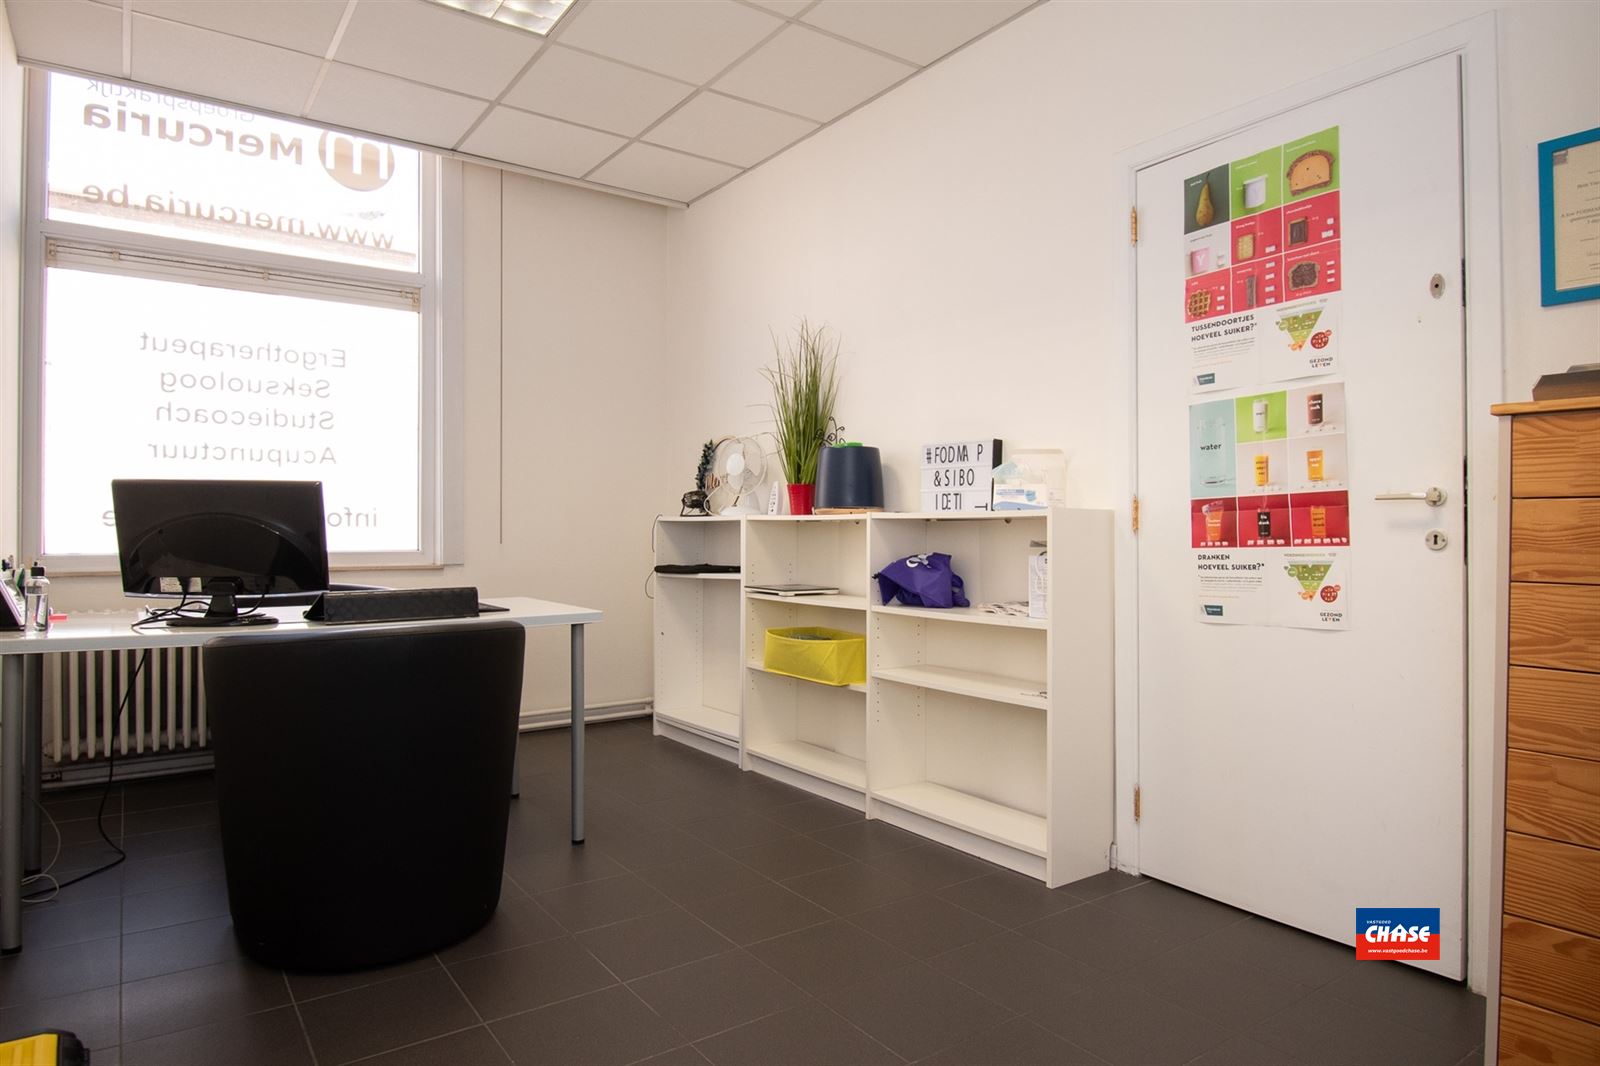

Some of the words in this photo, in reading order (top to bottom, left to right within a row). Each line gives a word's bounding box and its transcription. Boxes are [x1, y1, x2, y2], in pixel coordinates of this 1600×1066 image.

[1191, 314, 1255, 332] TUSSENDOORTJES
[1191, 331, 1222, 342] HOEVEEL
[1200, 443, 1222, 451] water
[1198, 563, 1230, 571] HOEVEEL
